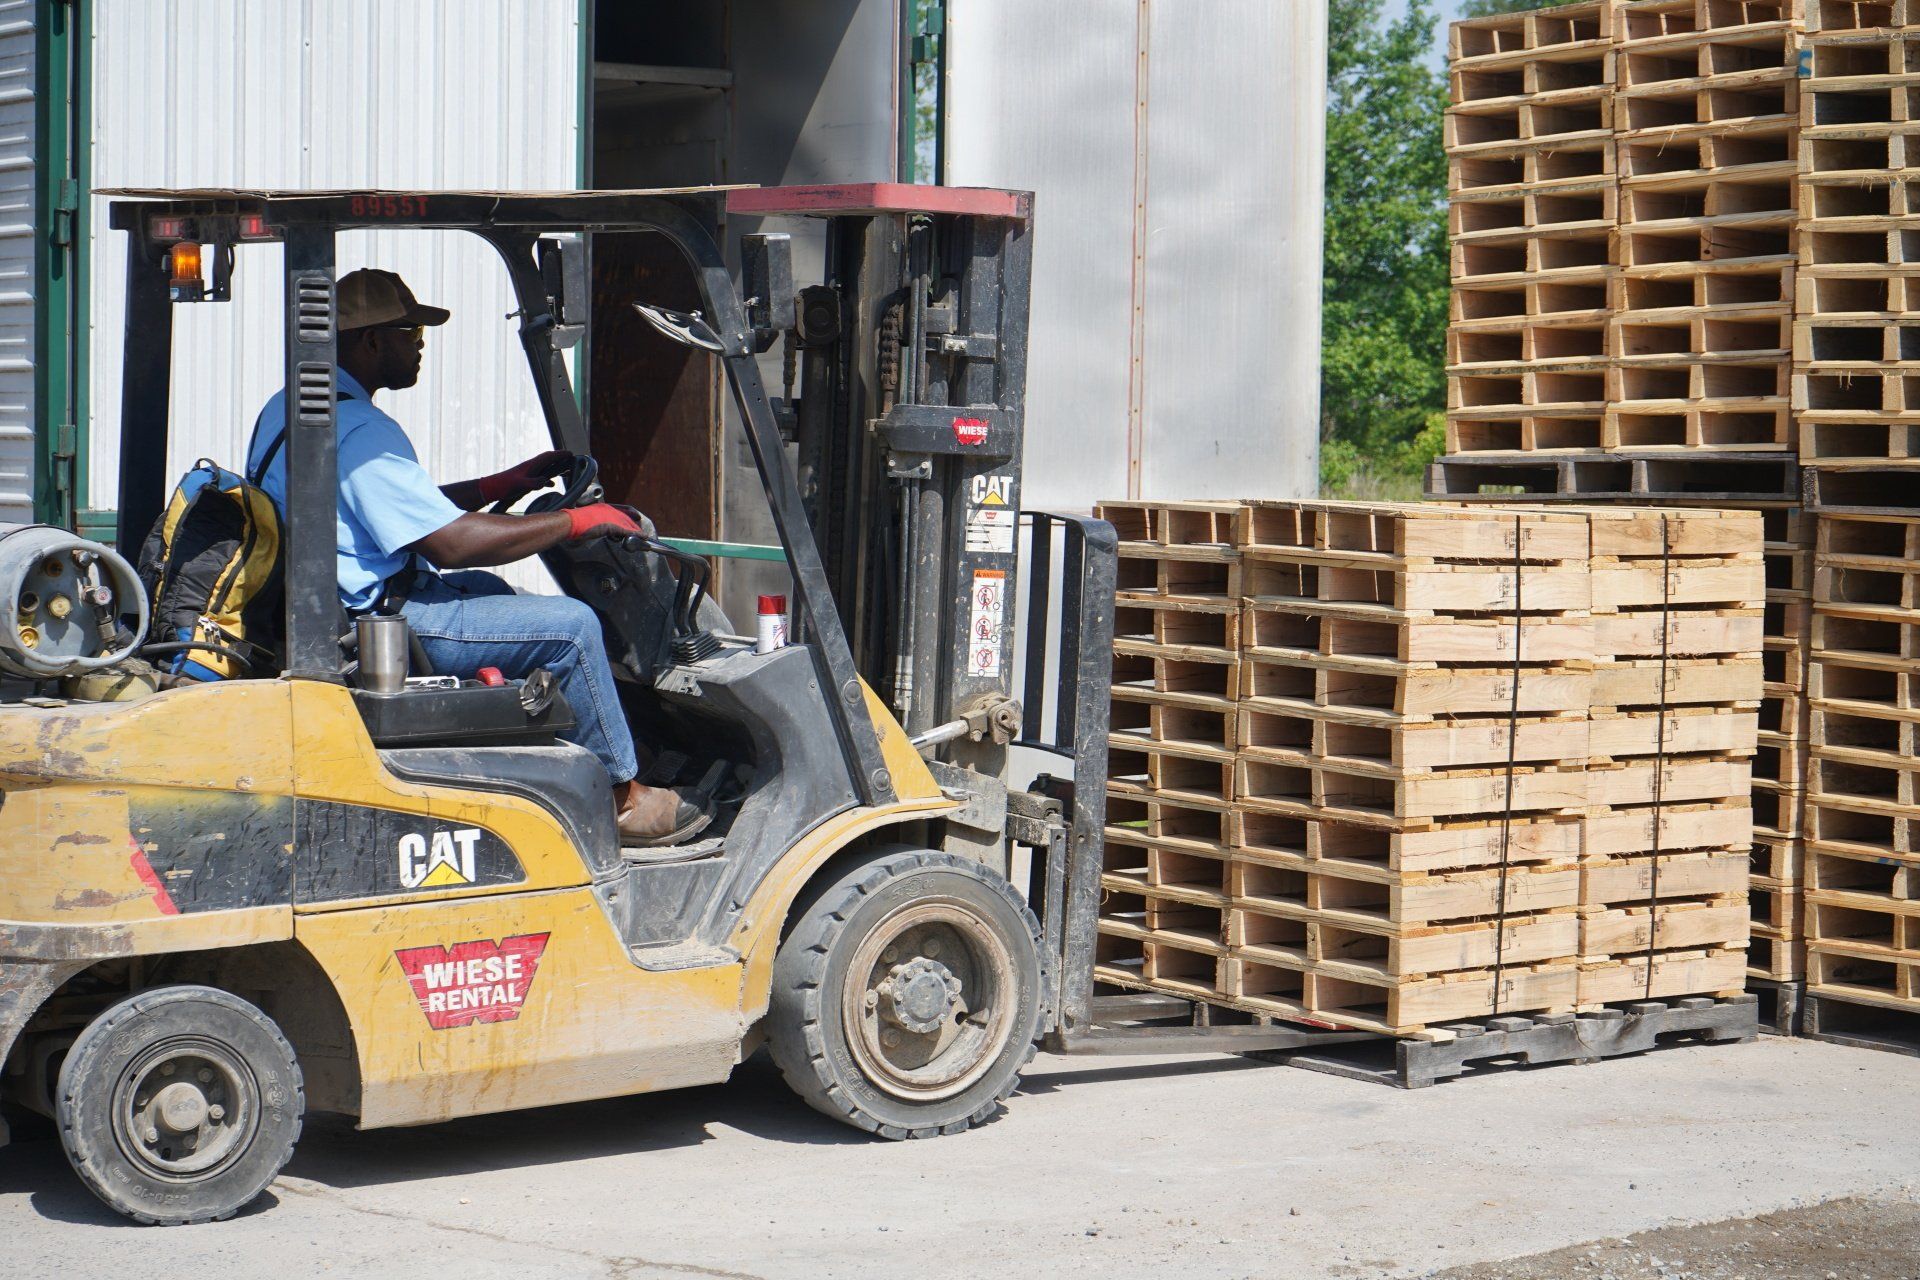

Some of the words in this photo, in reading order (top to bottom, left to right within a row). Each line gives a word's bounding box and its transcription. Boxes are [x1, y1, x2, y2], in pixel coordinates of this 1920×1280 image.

[958, 425, 988, 436] WIESE
[972, 474, 1013, 506] CAT
[399, 828, 481, 888] CAT
[423, 953, 522, 989] WIESE
[428, 982, 522, 1013] RENTAL
